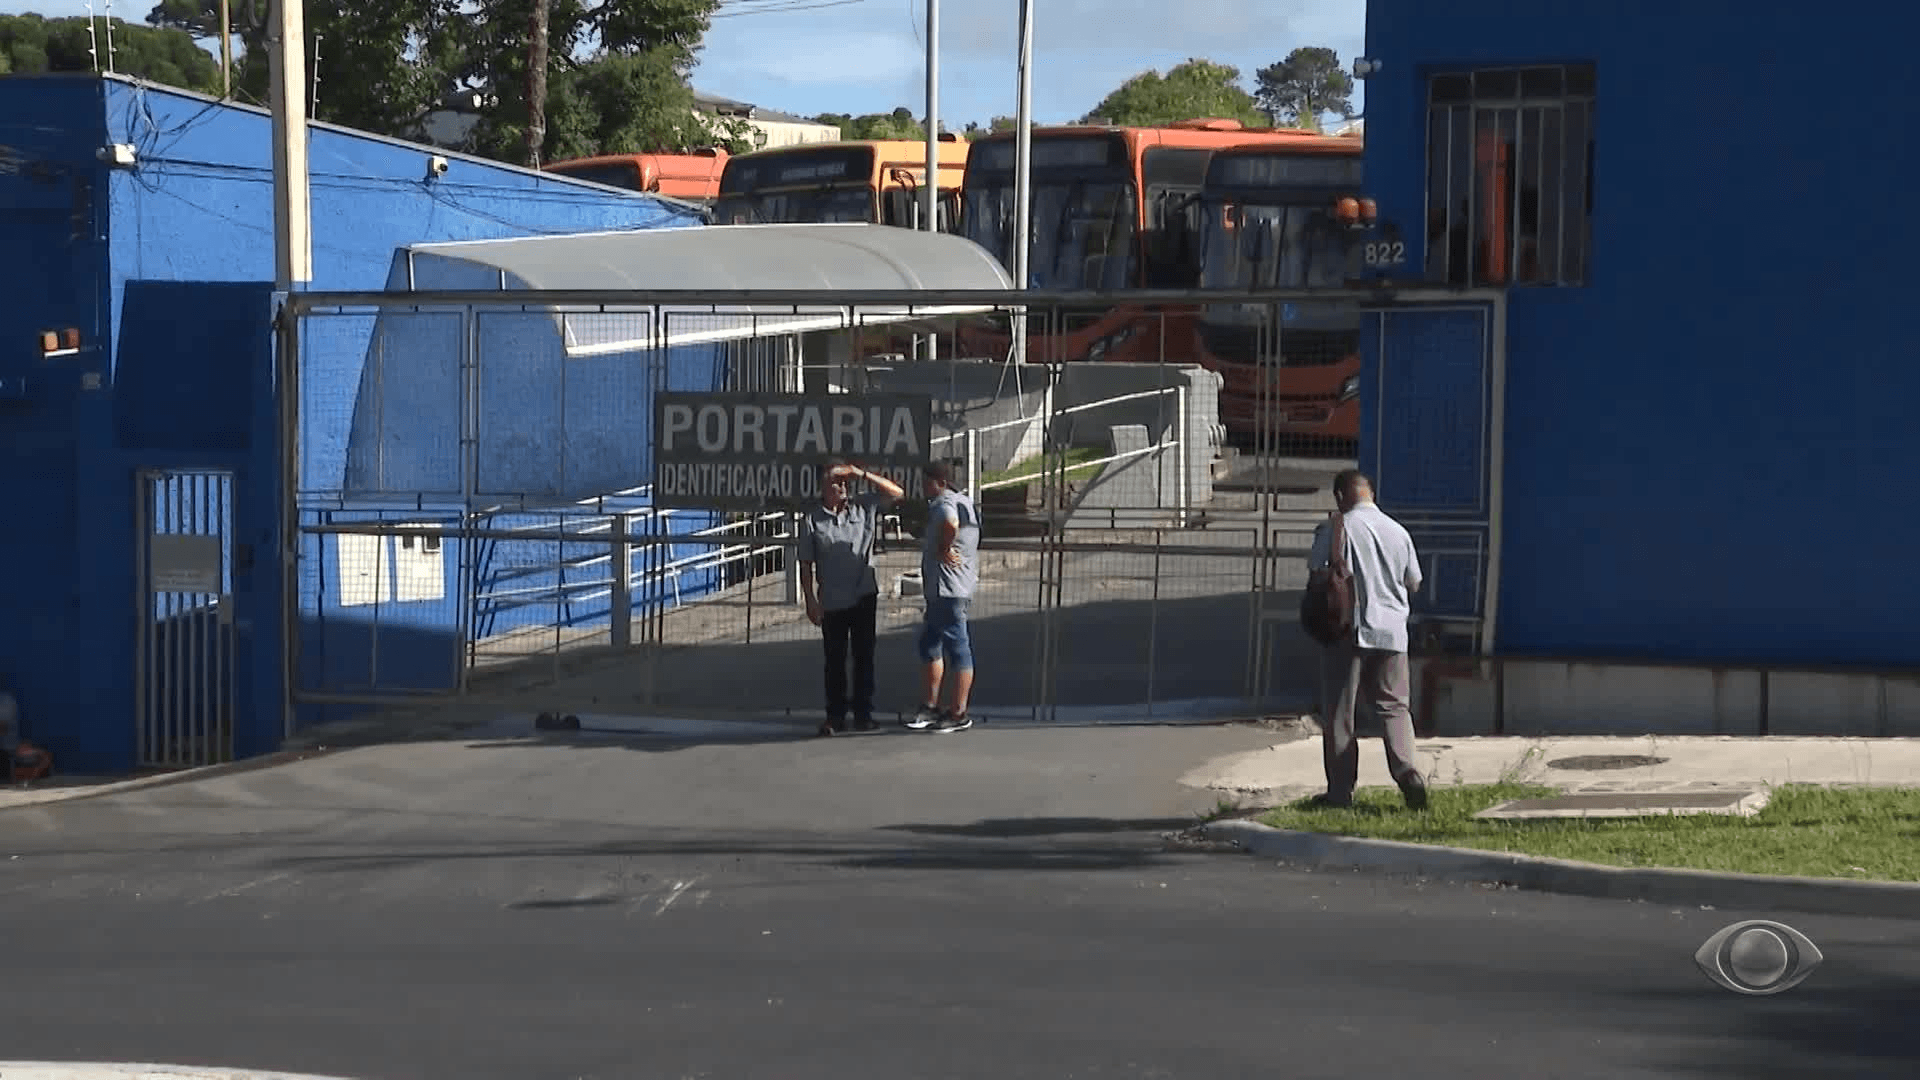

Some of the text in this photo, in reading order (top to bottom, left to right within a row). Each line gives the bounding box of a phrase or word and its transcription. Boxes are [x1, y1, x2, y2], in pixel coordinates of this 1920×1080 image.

[1365, 242, 1405, 264] 822
[662, 404, 920, 454] PORTARIA
[659, 461, 793, 505] IDENTIFICAÇÃO
